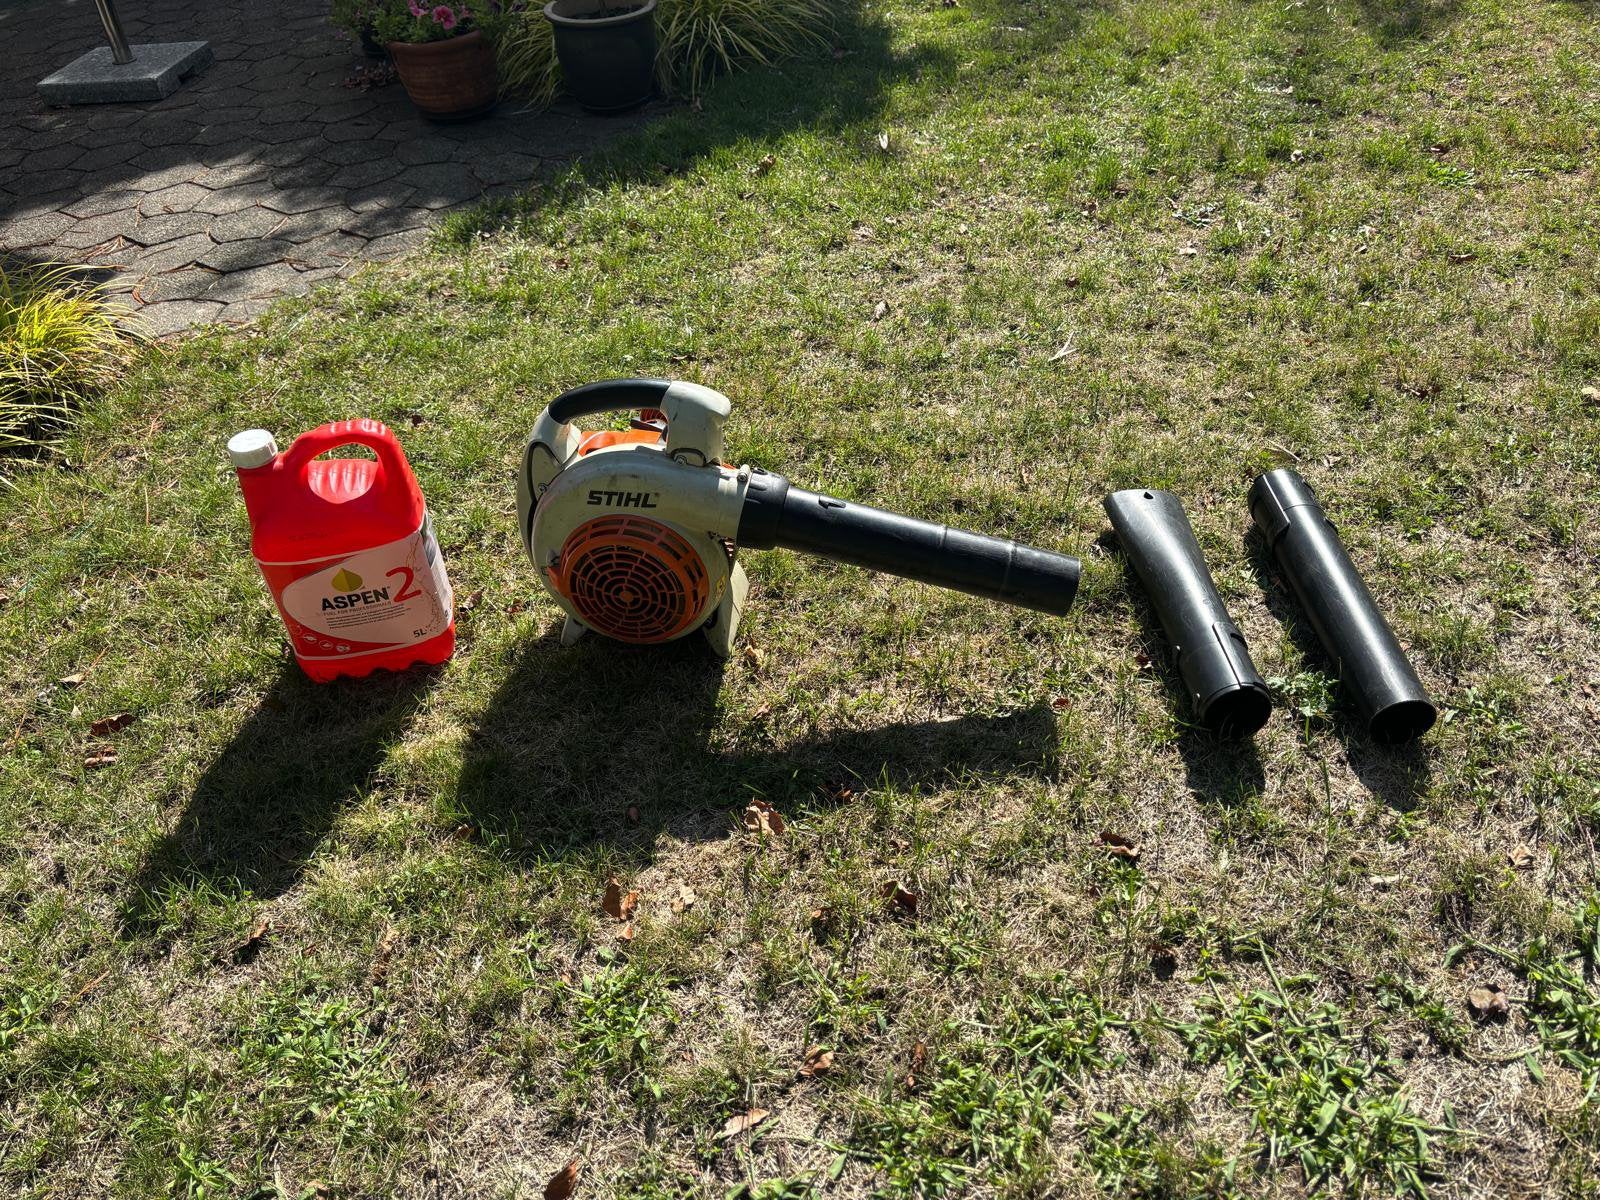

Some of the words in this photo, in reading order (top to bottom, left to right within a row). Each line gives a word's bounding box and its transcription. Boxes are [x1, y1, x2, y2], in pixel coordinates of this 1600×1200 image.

[587, 490, 657, 508] STIHL
[321, 587, 390, 611] ASPEN
[386, 566, 422, 603] 2
[413, 628, 427, 638] 5L
